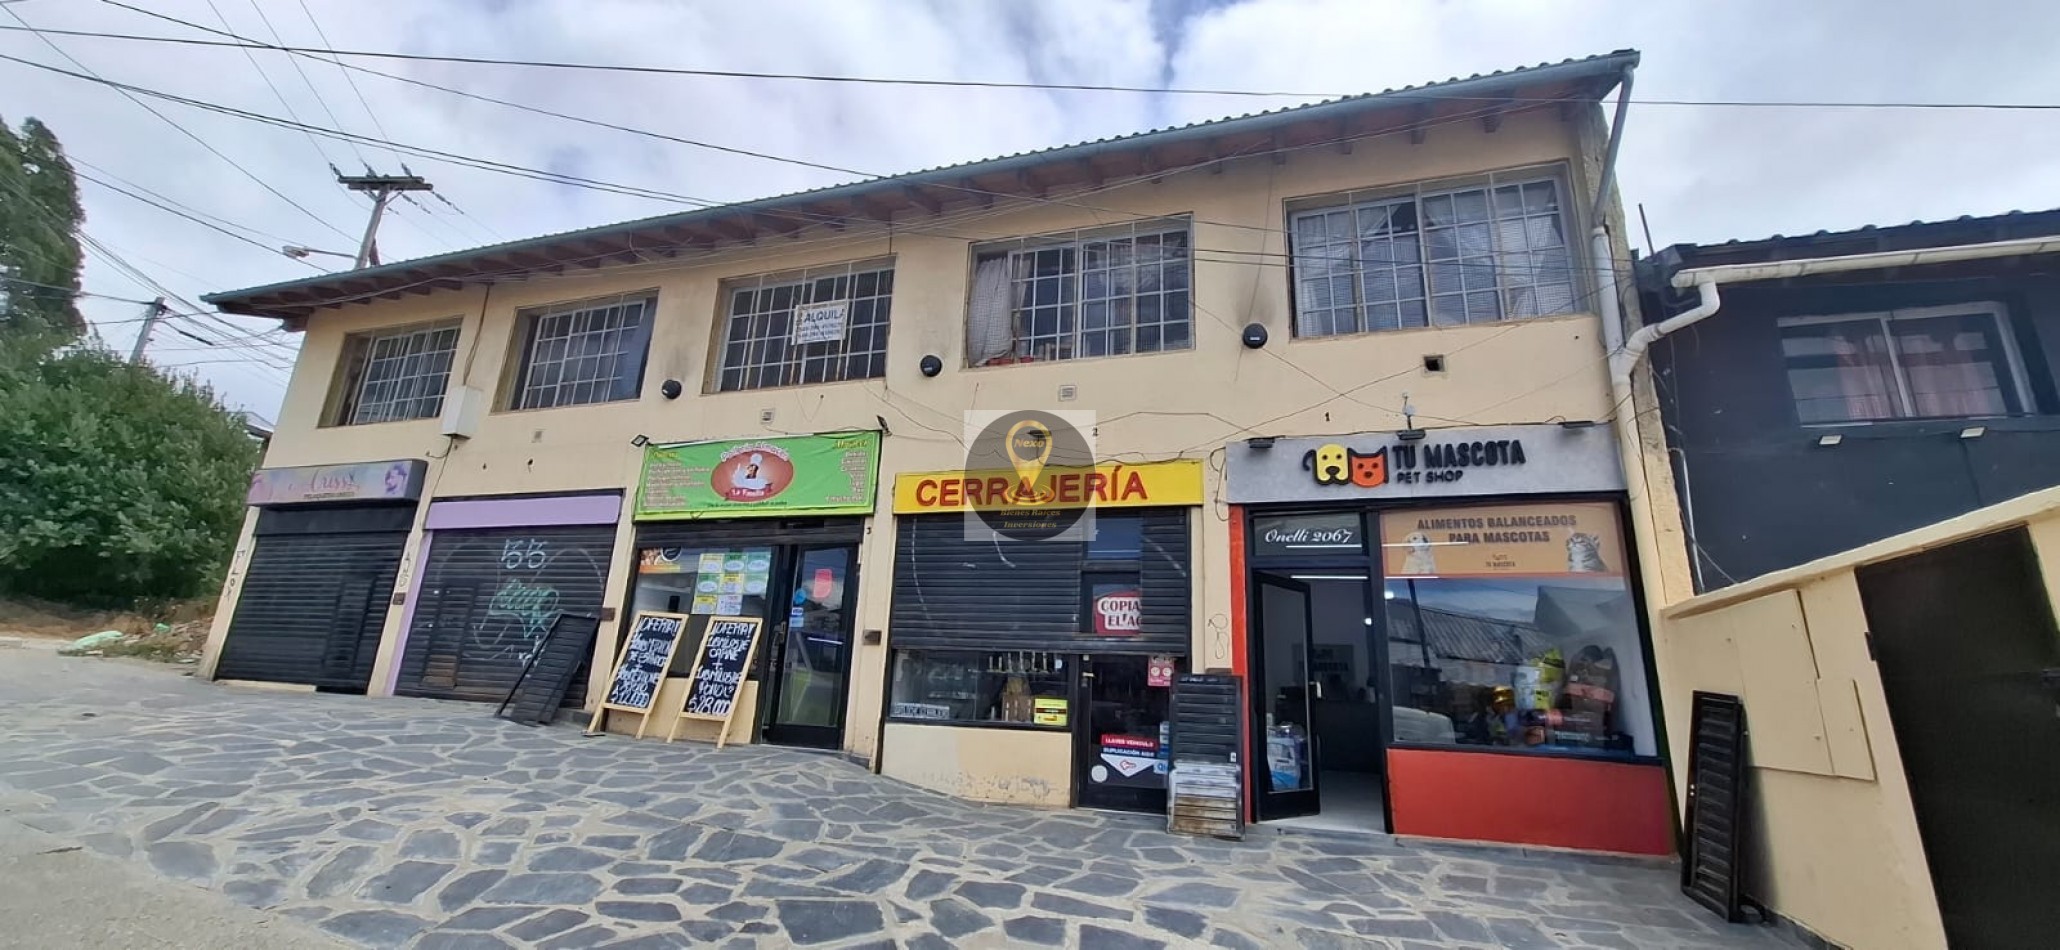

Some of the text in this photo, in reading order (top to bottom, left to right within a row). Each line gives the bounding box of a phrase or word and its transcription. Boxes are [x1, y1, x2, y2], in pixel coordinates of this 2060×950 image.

[1325, 412, 1330, 422] 1
[1392, 439, 1527, 470] TU MASCOTA
[1397, 470, 1463, 484] PET SHOP
[916, 465, 1148, 507] CERRAJERÍA
[1417, 514, 1577, 530] ALIMENTOS BALANCEADOS
[1265, 528, 1353, 543] Onelli 2067
[1449, 531, 1550, 544] PARA MASCOTAS
